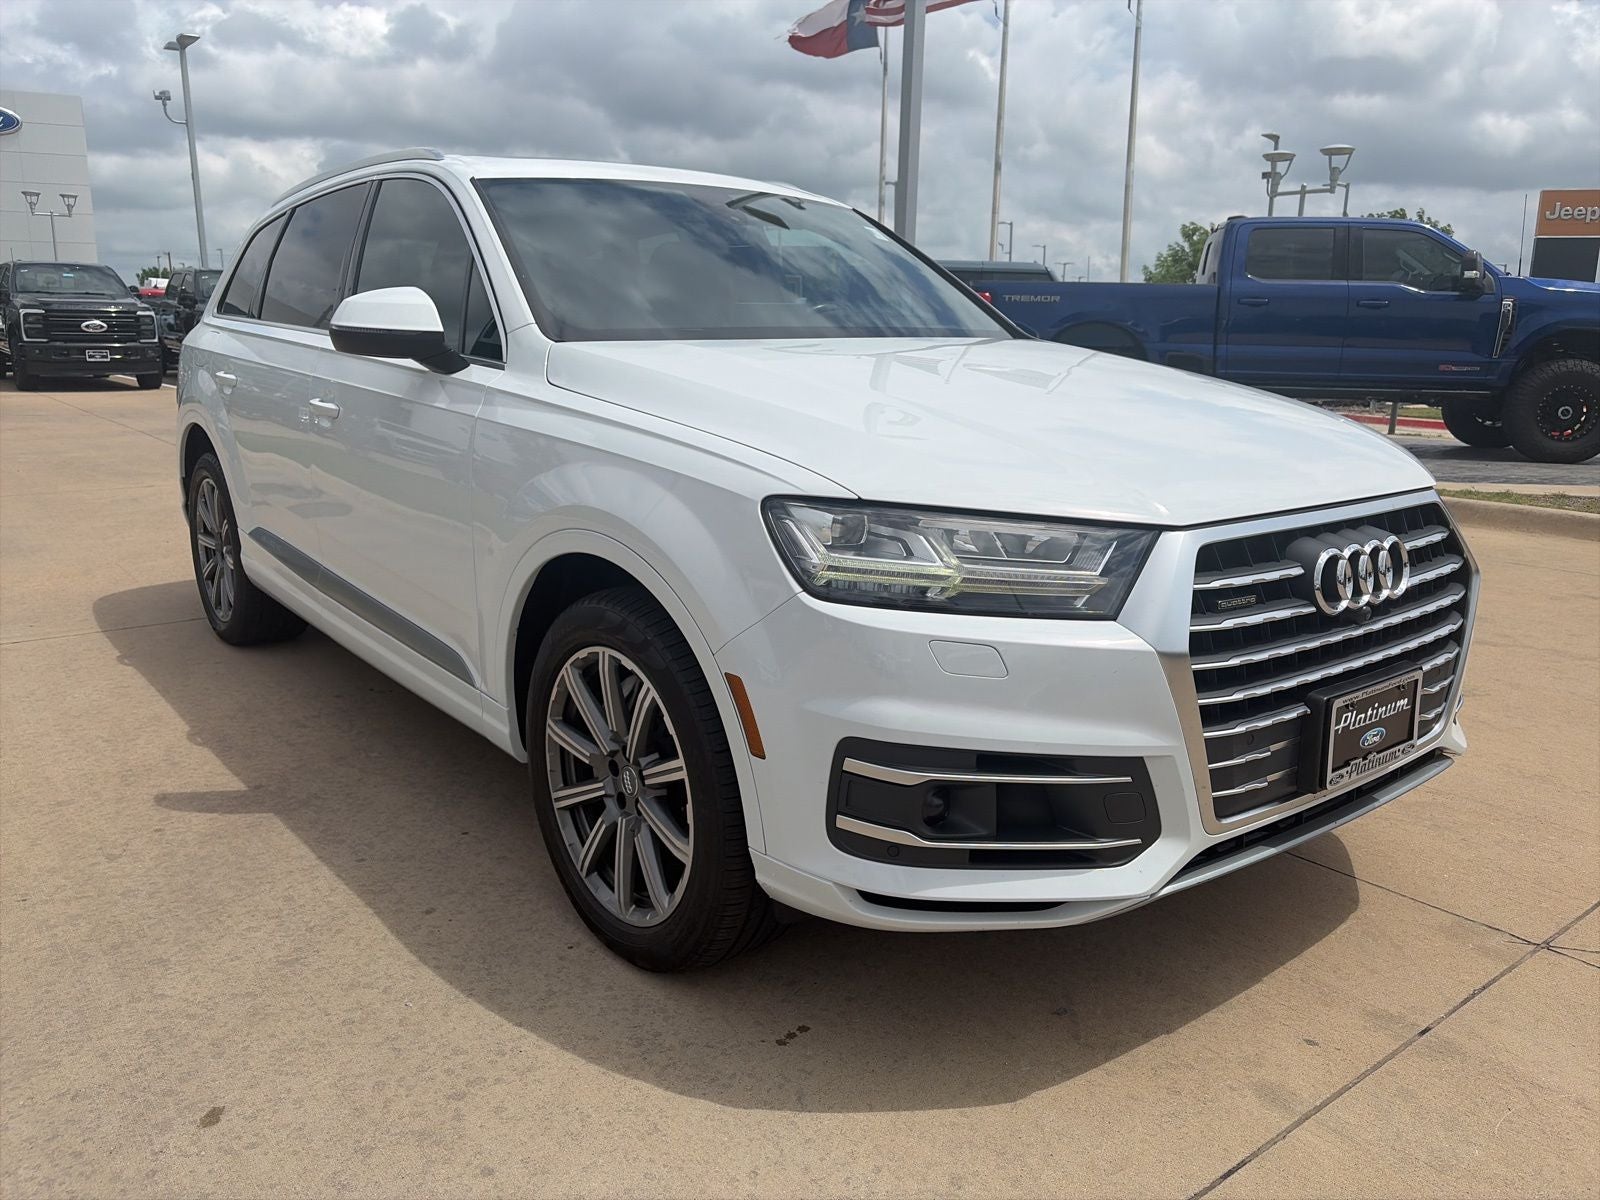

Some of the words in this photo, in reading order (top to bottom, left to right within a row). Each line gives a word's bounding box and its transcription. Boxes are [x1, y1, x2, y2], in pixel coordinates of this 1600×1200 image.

[1545, 202, 1600, 223] Jeep
[1003, 294, 1061, 303] TREMOR
[1334, 697, 1411, 734] Platinum
[1363, 730, 1383, 747] Ford
